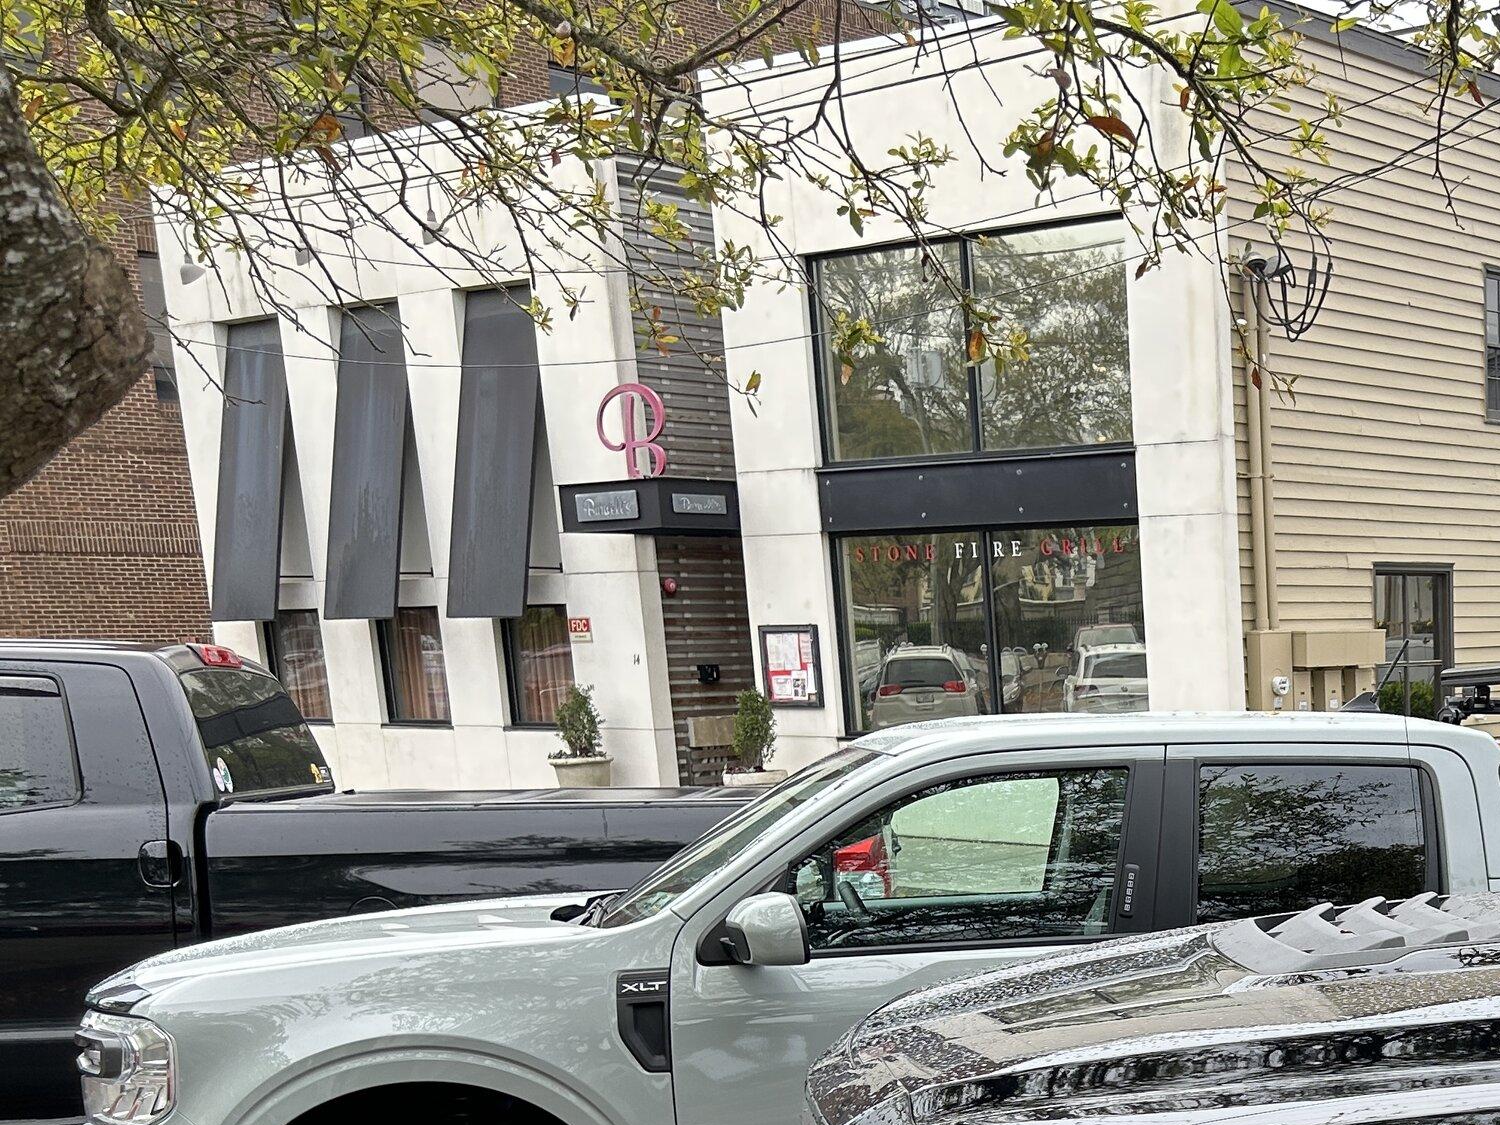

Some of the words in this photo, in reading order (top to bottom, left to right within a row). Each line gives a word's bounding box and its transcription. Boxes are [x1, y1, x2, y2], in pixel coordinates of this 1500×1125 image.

[855, 543, 937, 563] STONE
[955, 540, 1022, 560] FIRE
[1040, 537, 1124, 557] GRILL
[571, 619, 588, 632] FDC
[621, 981, 667, 993] XLT
